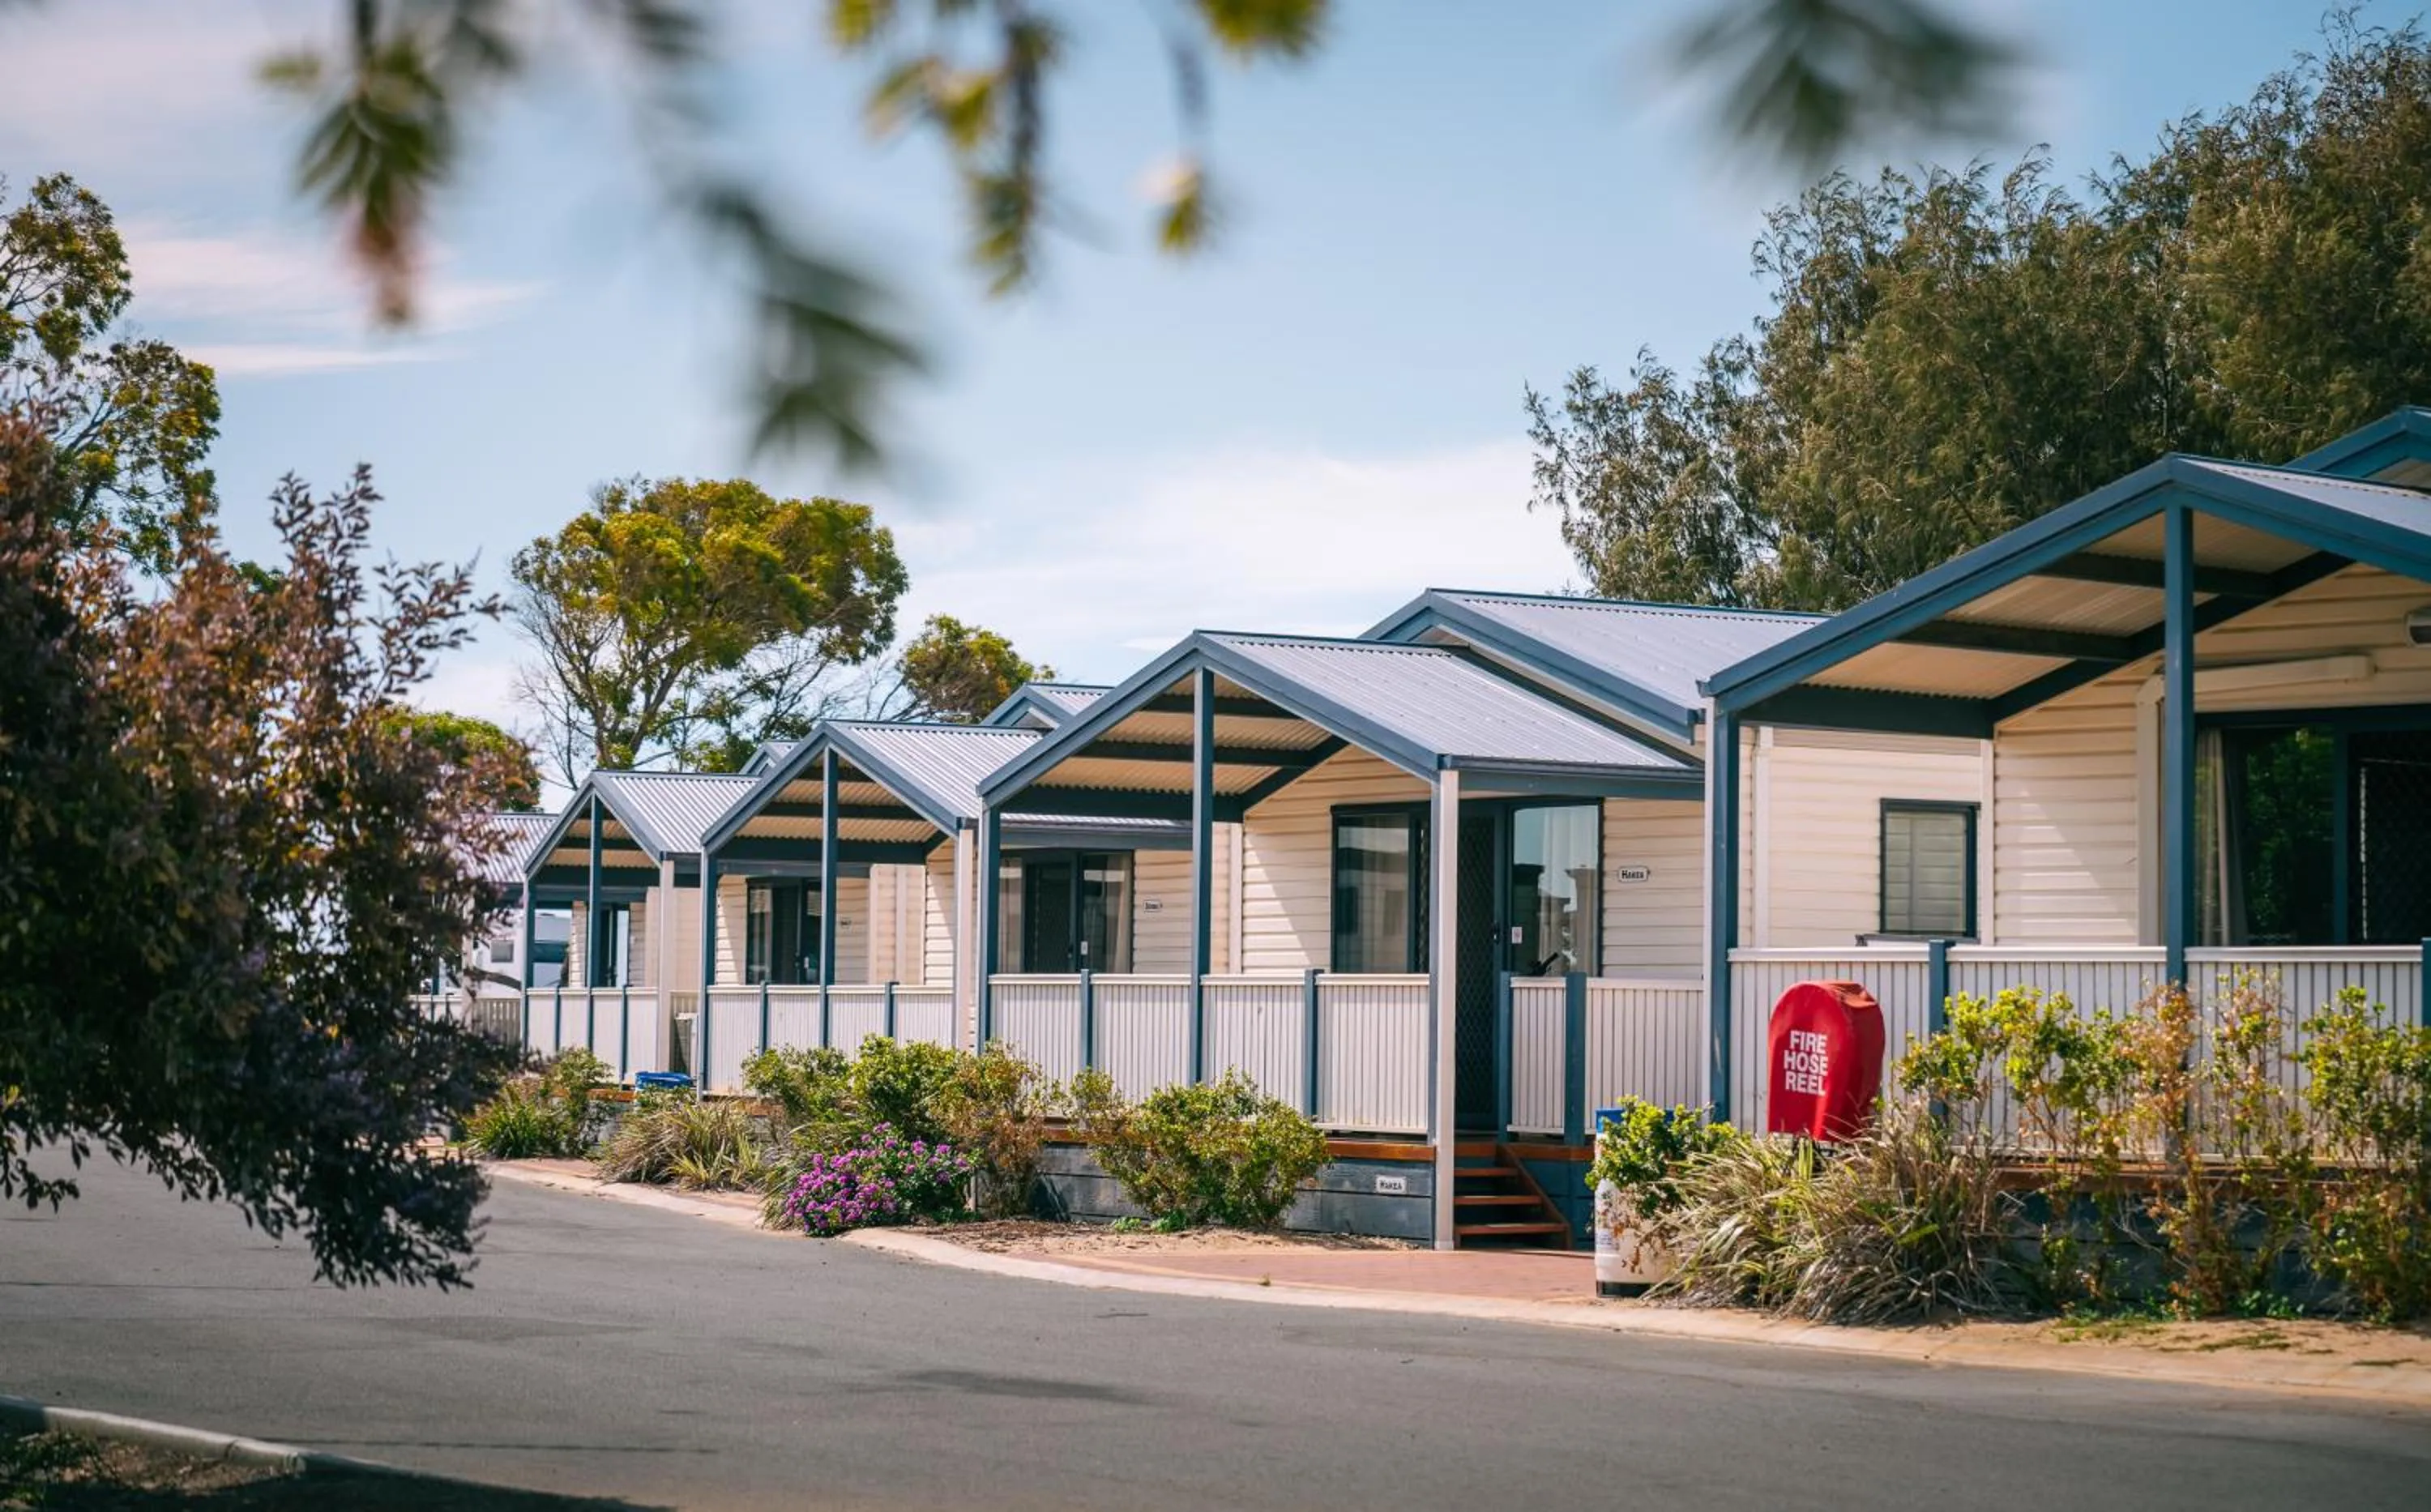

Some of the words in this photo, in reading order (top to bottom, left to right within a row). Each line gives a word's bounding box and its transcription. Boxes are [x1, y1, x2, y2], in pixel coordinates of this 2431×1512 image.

[1789, 1030, 1828, 1054] FIRE
[1784, 1049, 1829, 1077] HOSE
[1785, 1070, 1826, 1097] REEL
